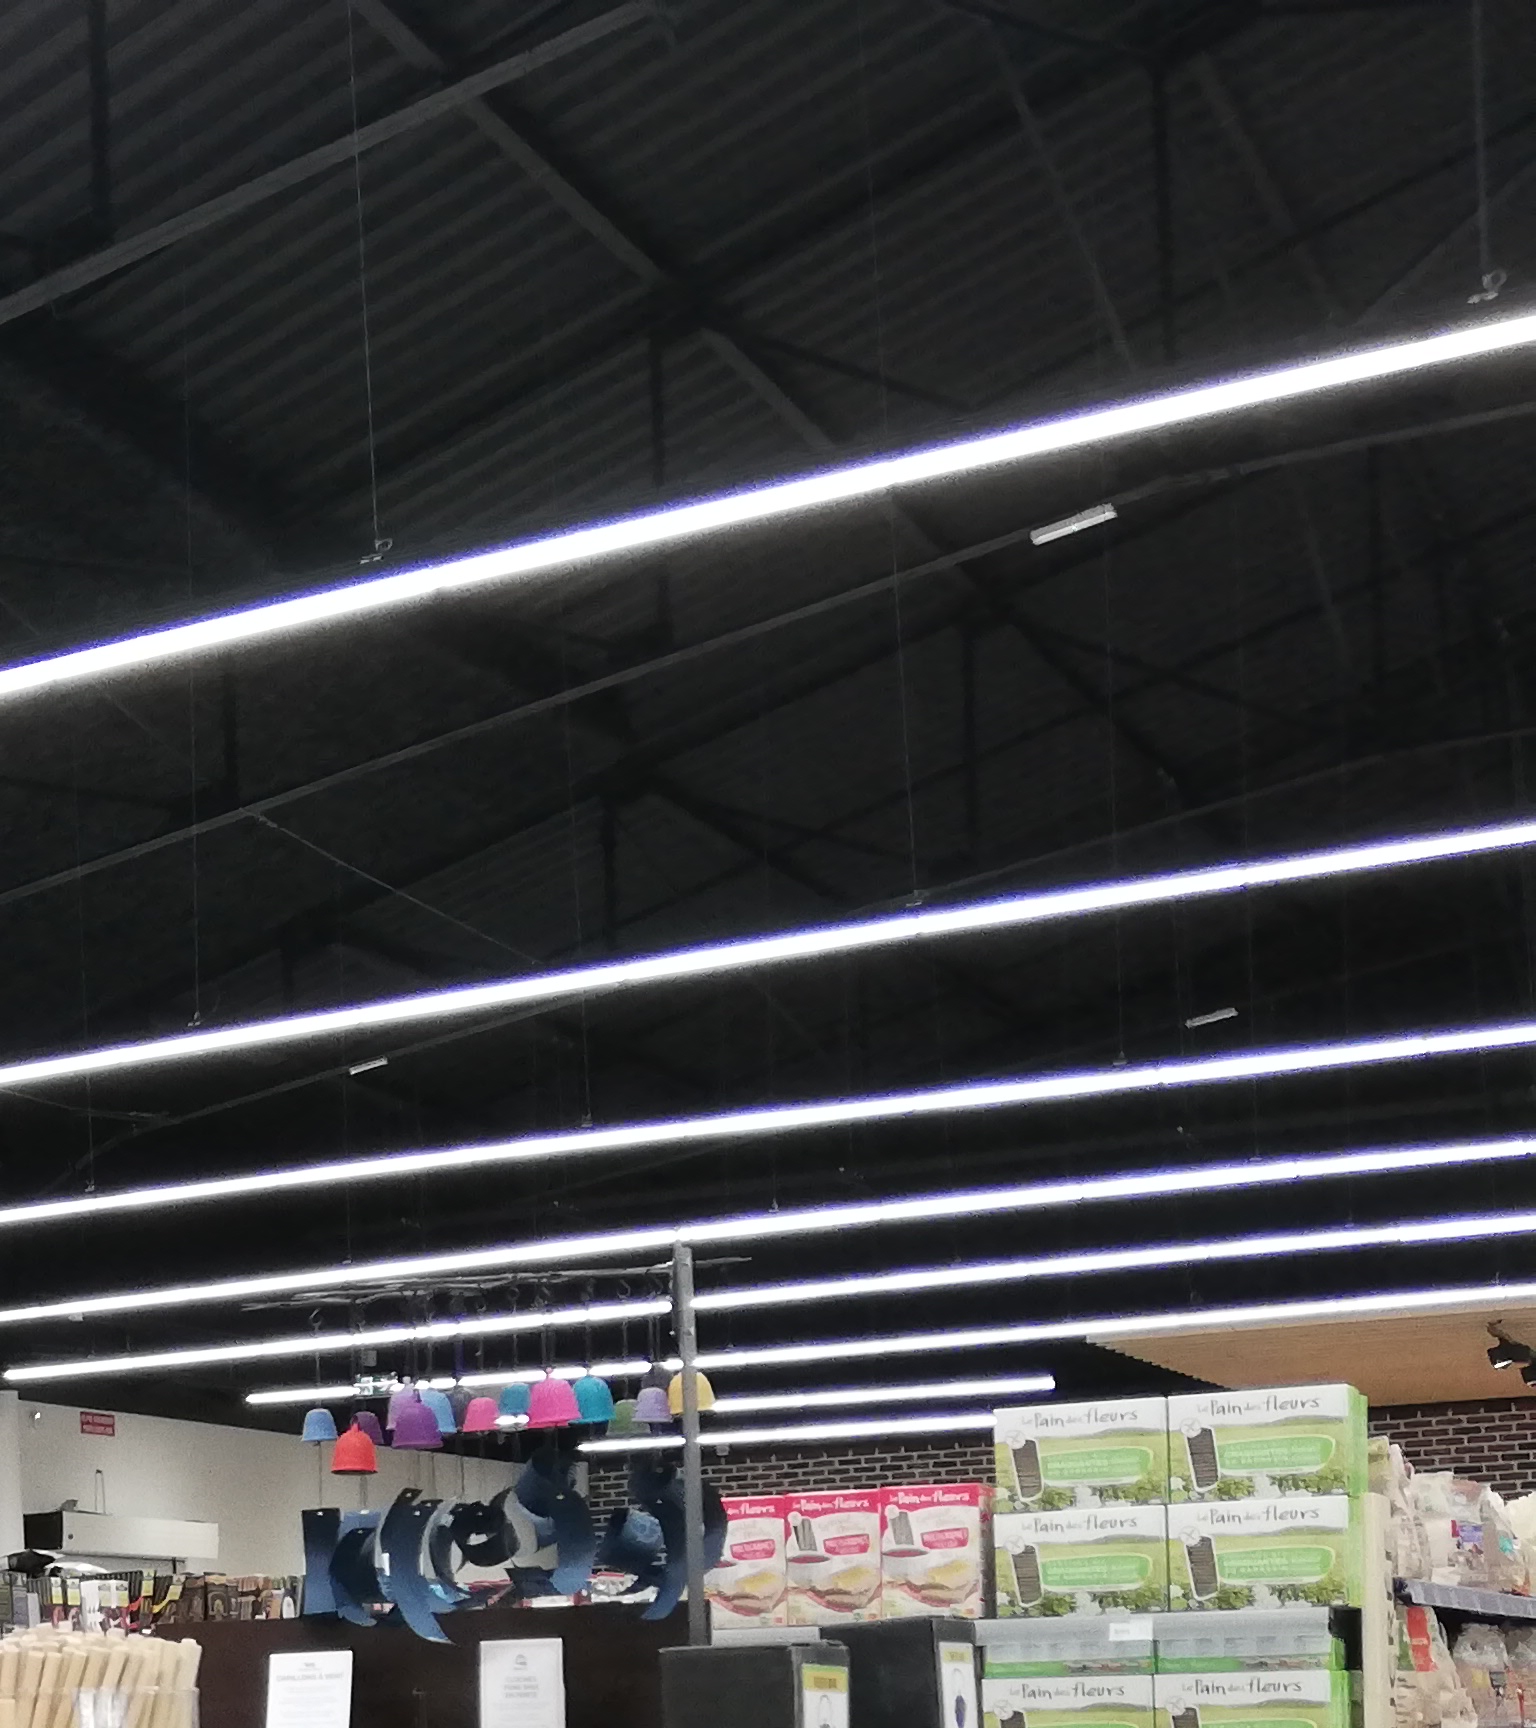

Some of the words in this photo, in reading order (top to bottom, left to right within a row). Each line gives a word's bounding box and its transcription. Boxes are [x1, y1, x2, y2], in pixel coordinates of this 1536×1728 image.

[1211, 1399, 1242, 1416] Pain
[1263, 1395, 1320, 1412] fleurs
[1034, 1411, 1064, 1428] Pain
[1085, 1407, 1137, 1424] fleurs
[1034, 1517, 1064, 1533] Pain
[1085, 1515, 1137, 1531] fleurs
[1210, 1509, 1242, 1525] Pain
[1263, 1507, 1320, 1522] fleurs
[1021, 1682, 1052, 1700] Pain
[1071, 1682, 1125, 1698] fleurs
[1194, 1678, 1226, 1695] Pain
[1246, 1677, 1302, 1693] fleurs
